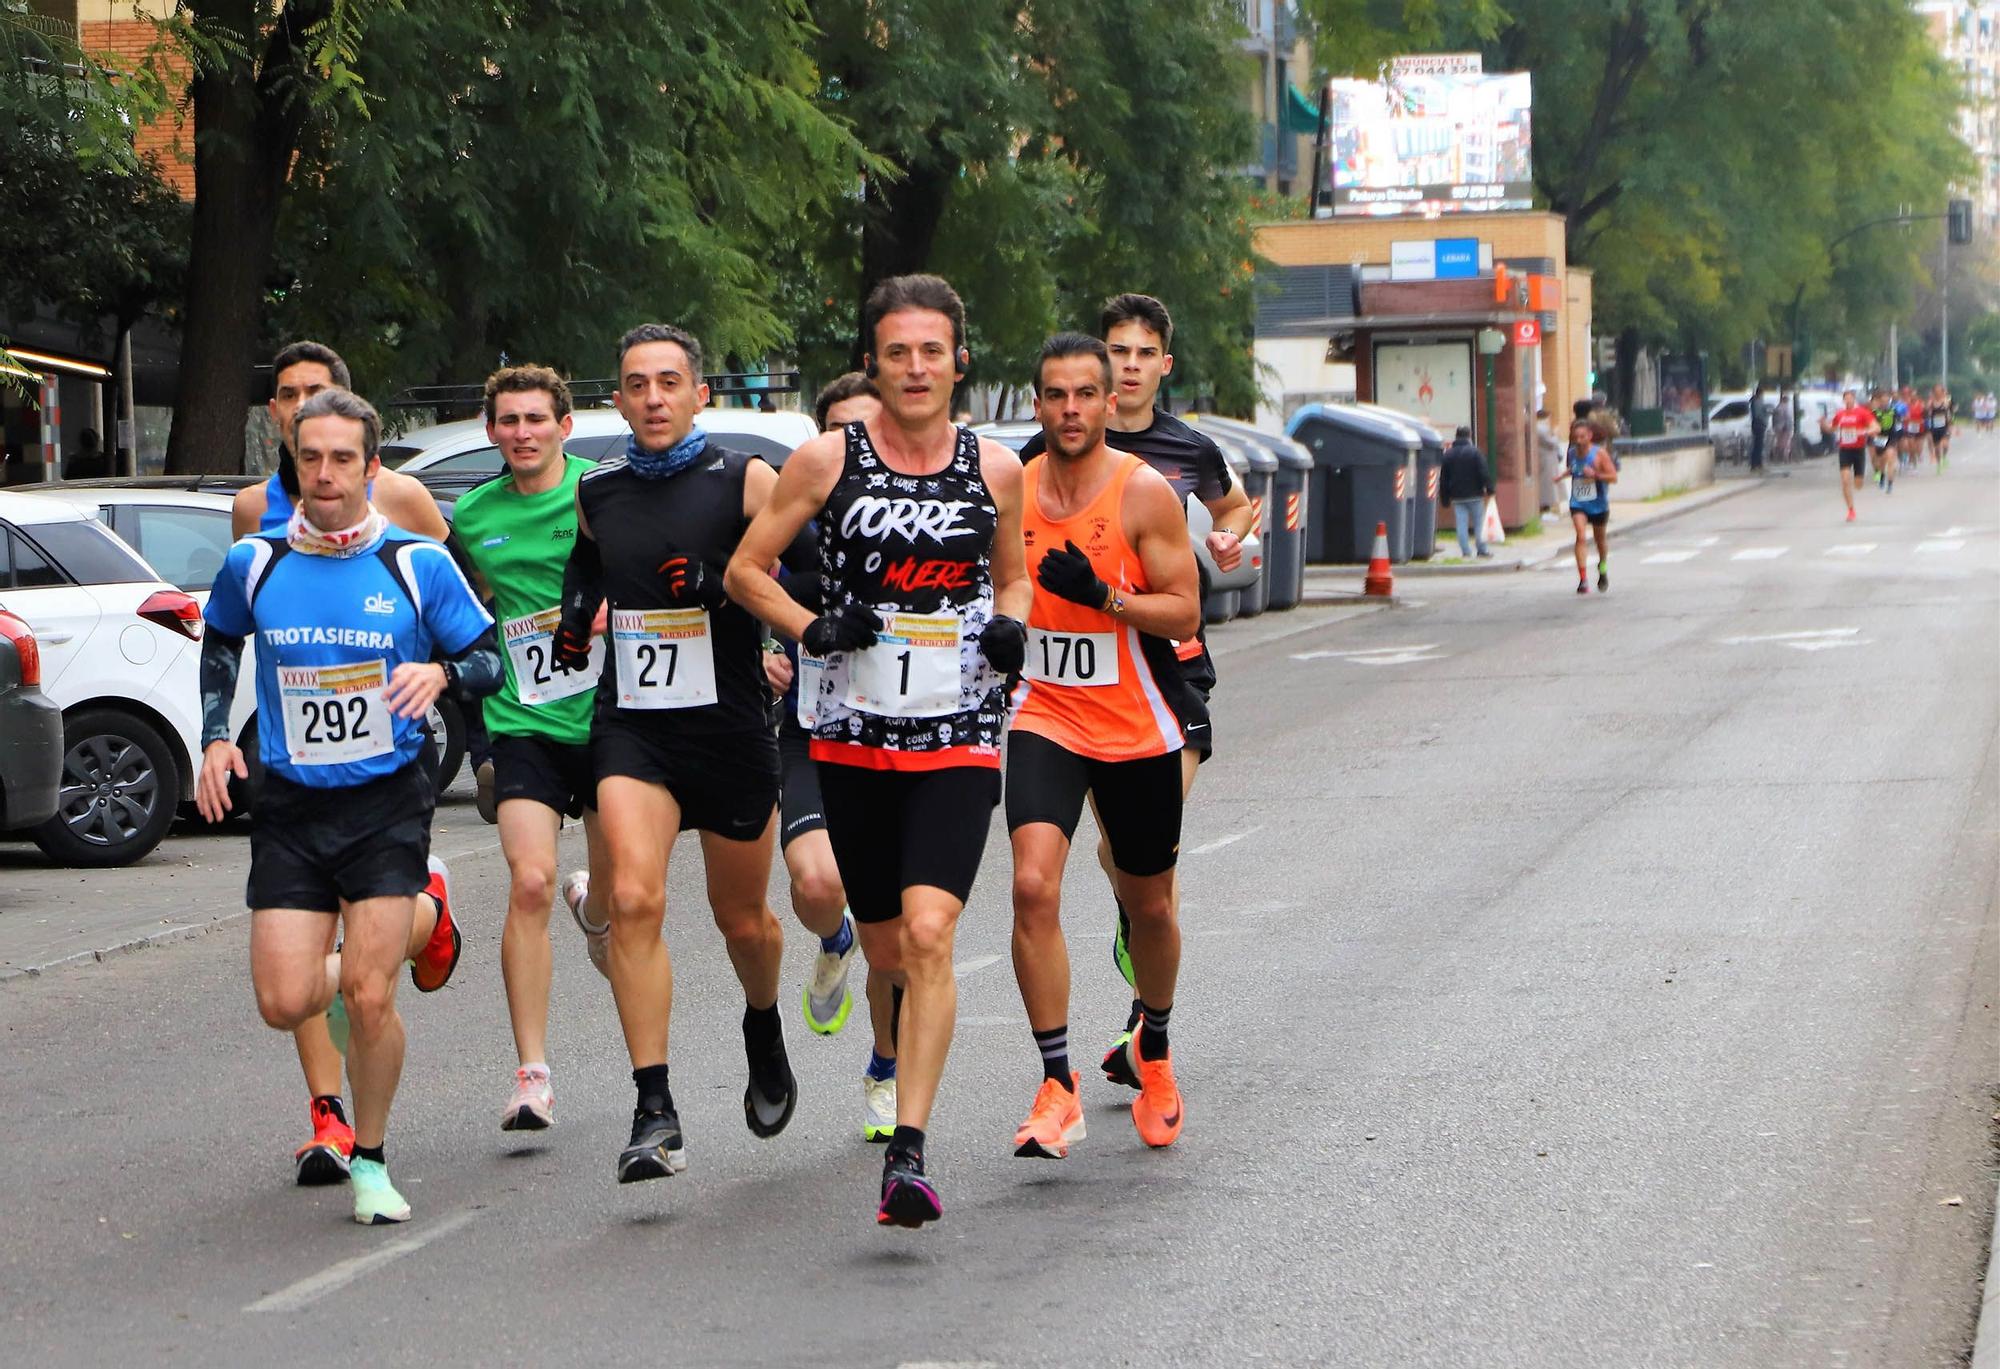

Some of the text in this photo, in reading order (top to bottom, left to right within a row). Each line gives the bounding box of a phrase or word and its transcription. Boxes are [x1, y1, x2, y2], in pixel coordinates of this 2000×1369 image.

[841, 495, 978, 546] CORRE
[865, 551, 976, 592] O MUERE
[264, 626, 395, 650] TROTASIERRA
[504, 618, 538, 639] XXXIX
[614, 615, 644, 631] XXXIX
[283, 670, 319, 688] XXXIX
[526, 640, 589, 685] 24
[637, 643, 679, 688] 27
[897, 650, 911, 696] 1
[1040, 635, 1096, 680] 170
[302, 696, 371, 744] 292
[906, 732, 933, 746] CORRE
